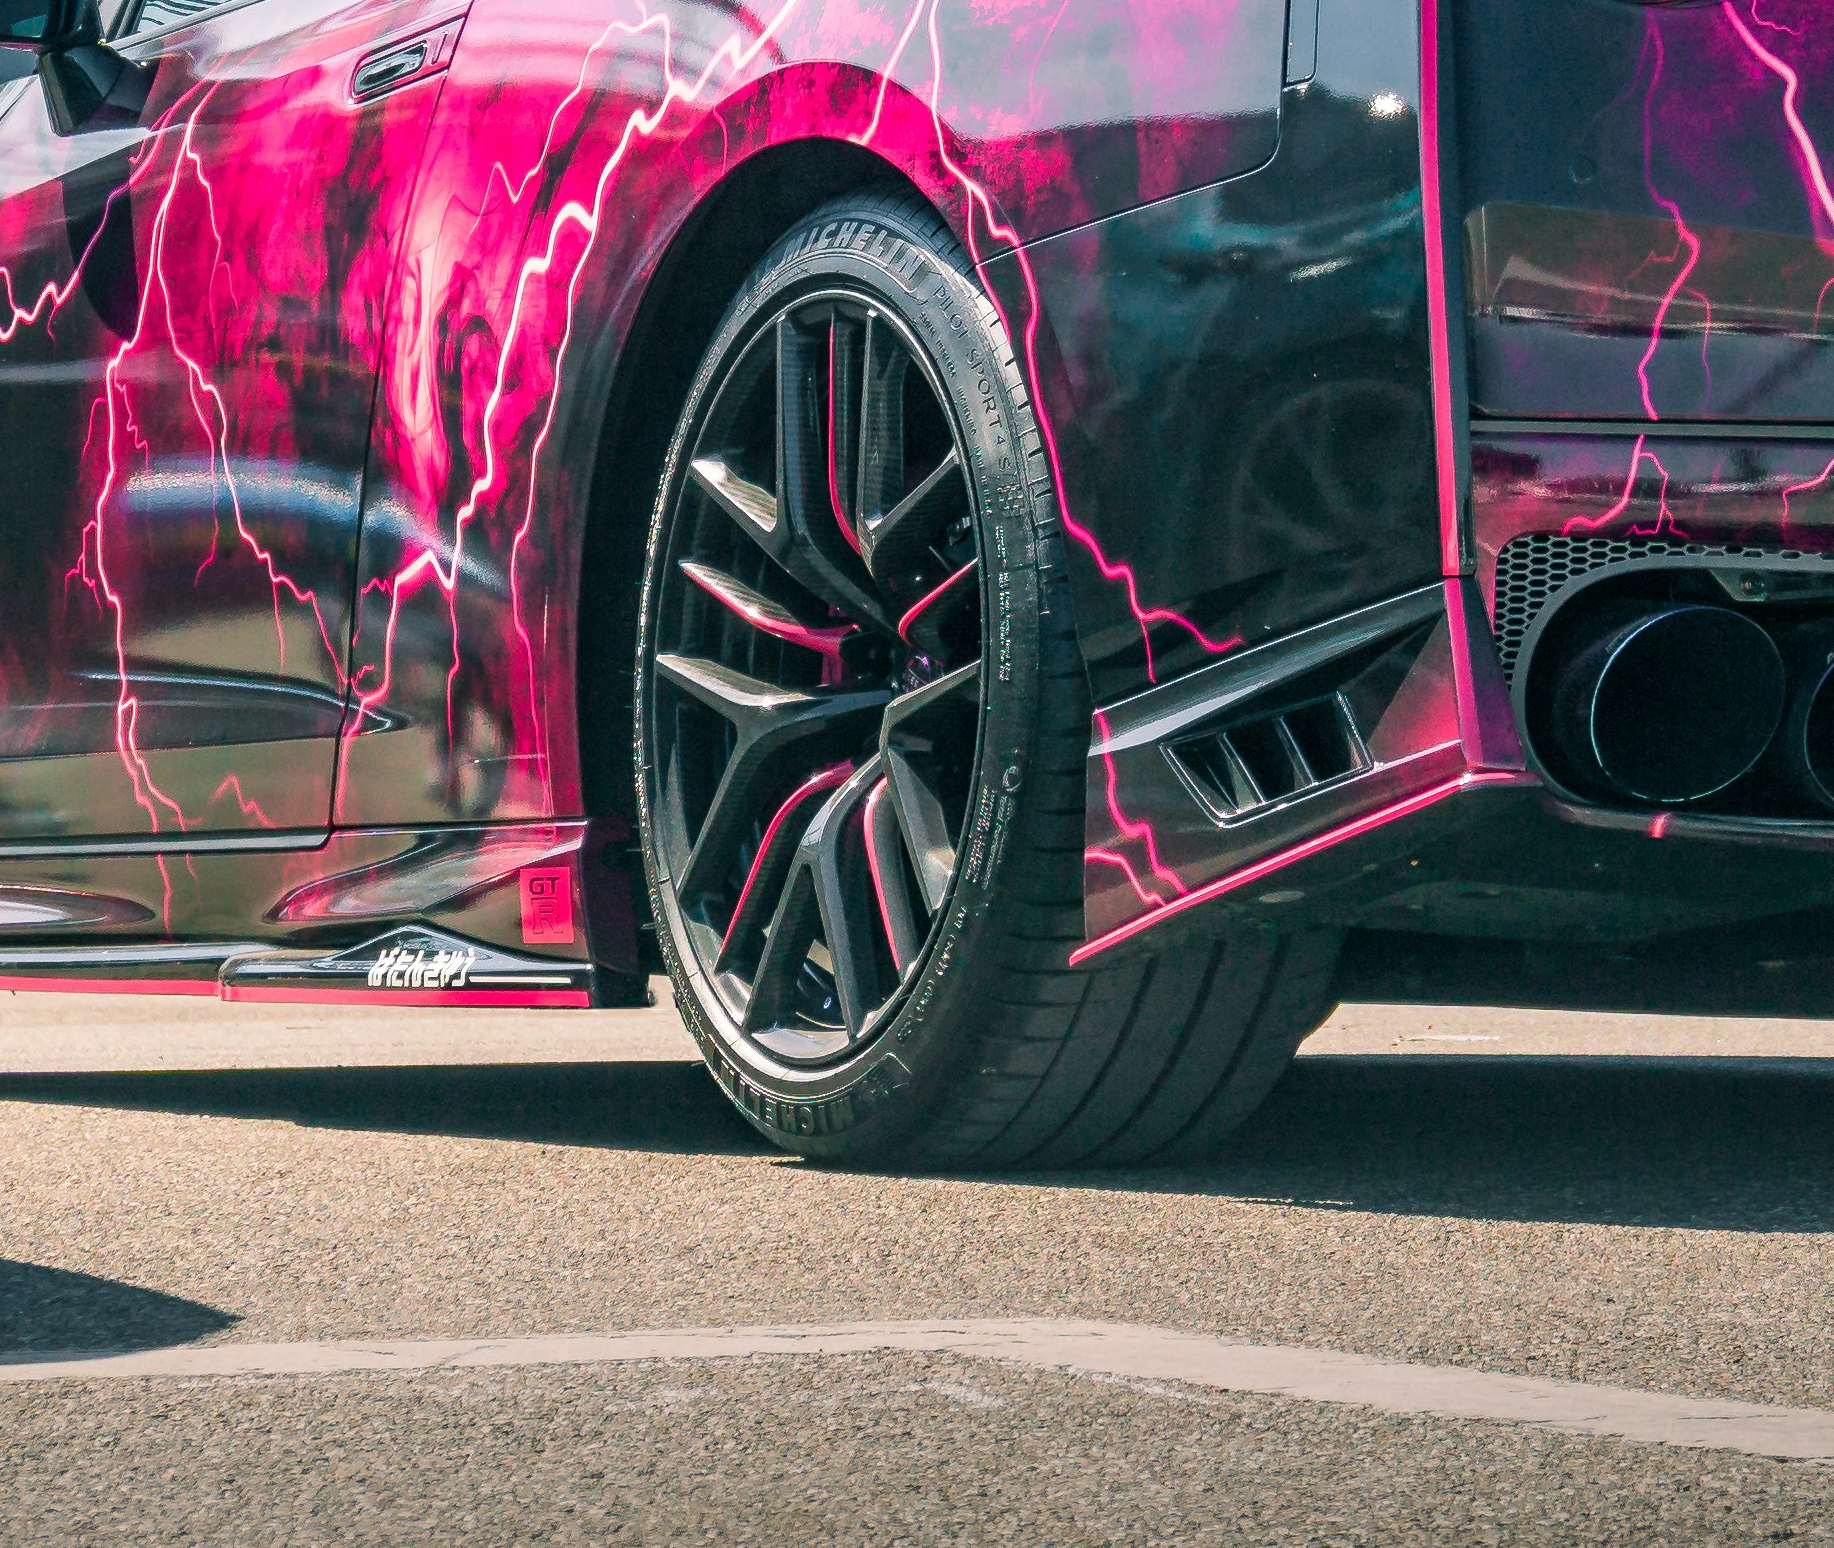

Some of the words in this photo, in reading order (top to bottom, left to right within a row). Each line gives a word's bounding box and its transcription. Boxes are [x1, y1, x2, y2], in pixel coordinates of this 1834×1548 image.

[781, 221, 928, 283] MICHELIN
[932, 284, 971, 341] PILOT
[965, 346, 1004, 429] SPORT
